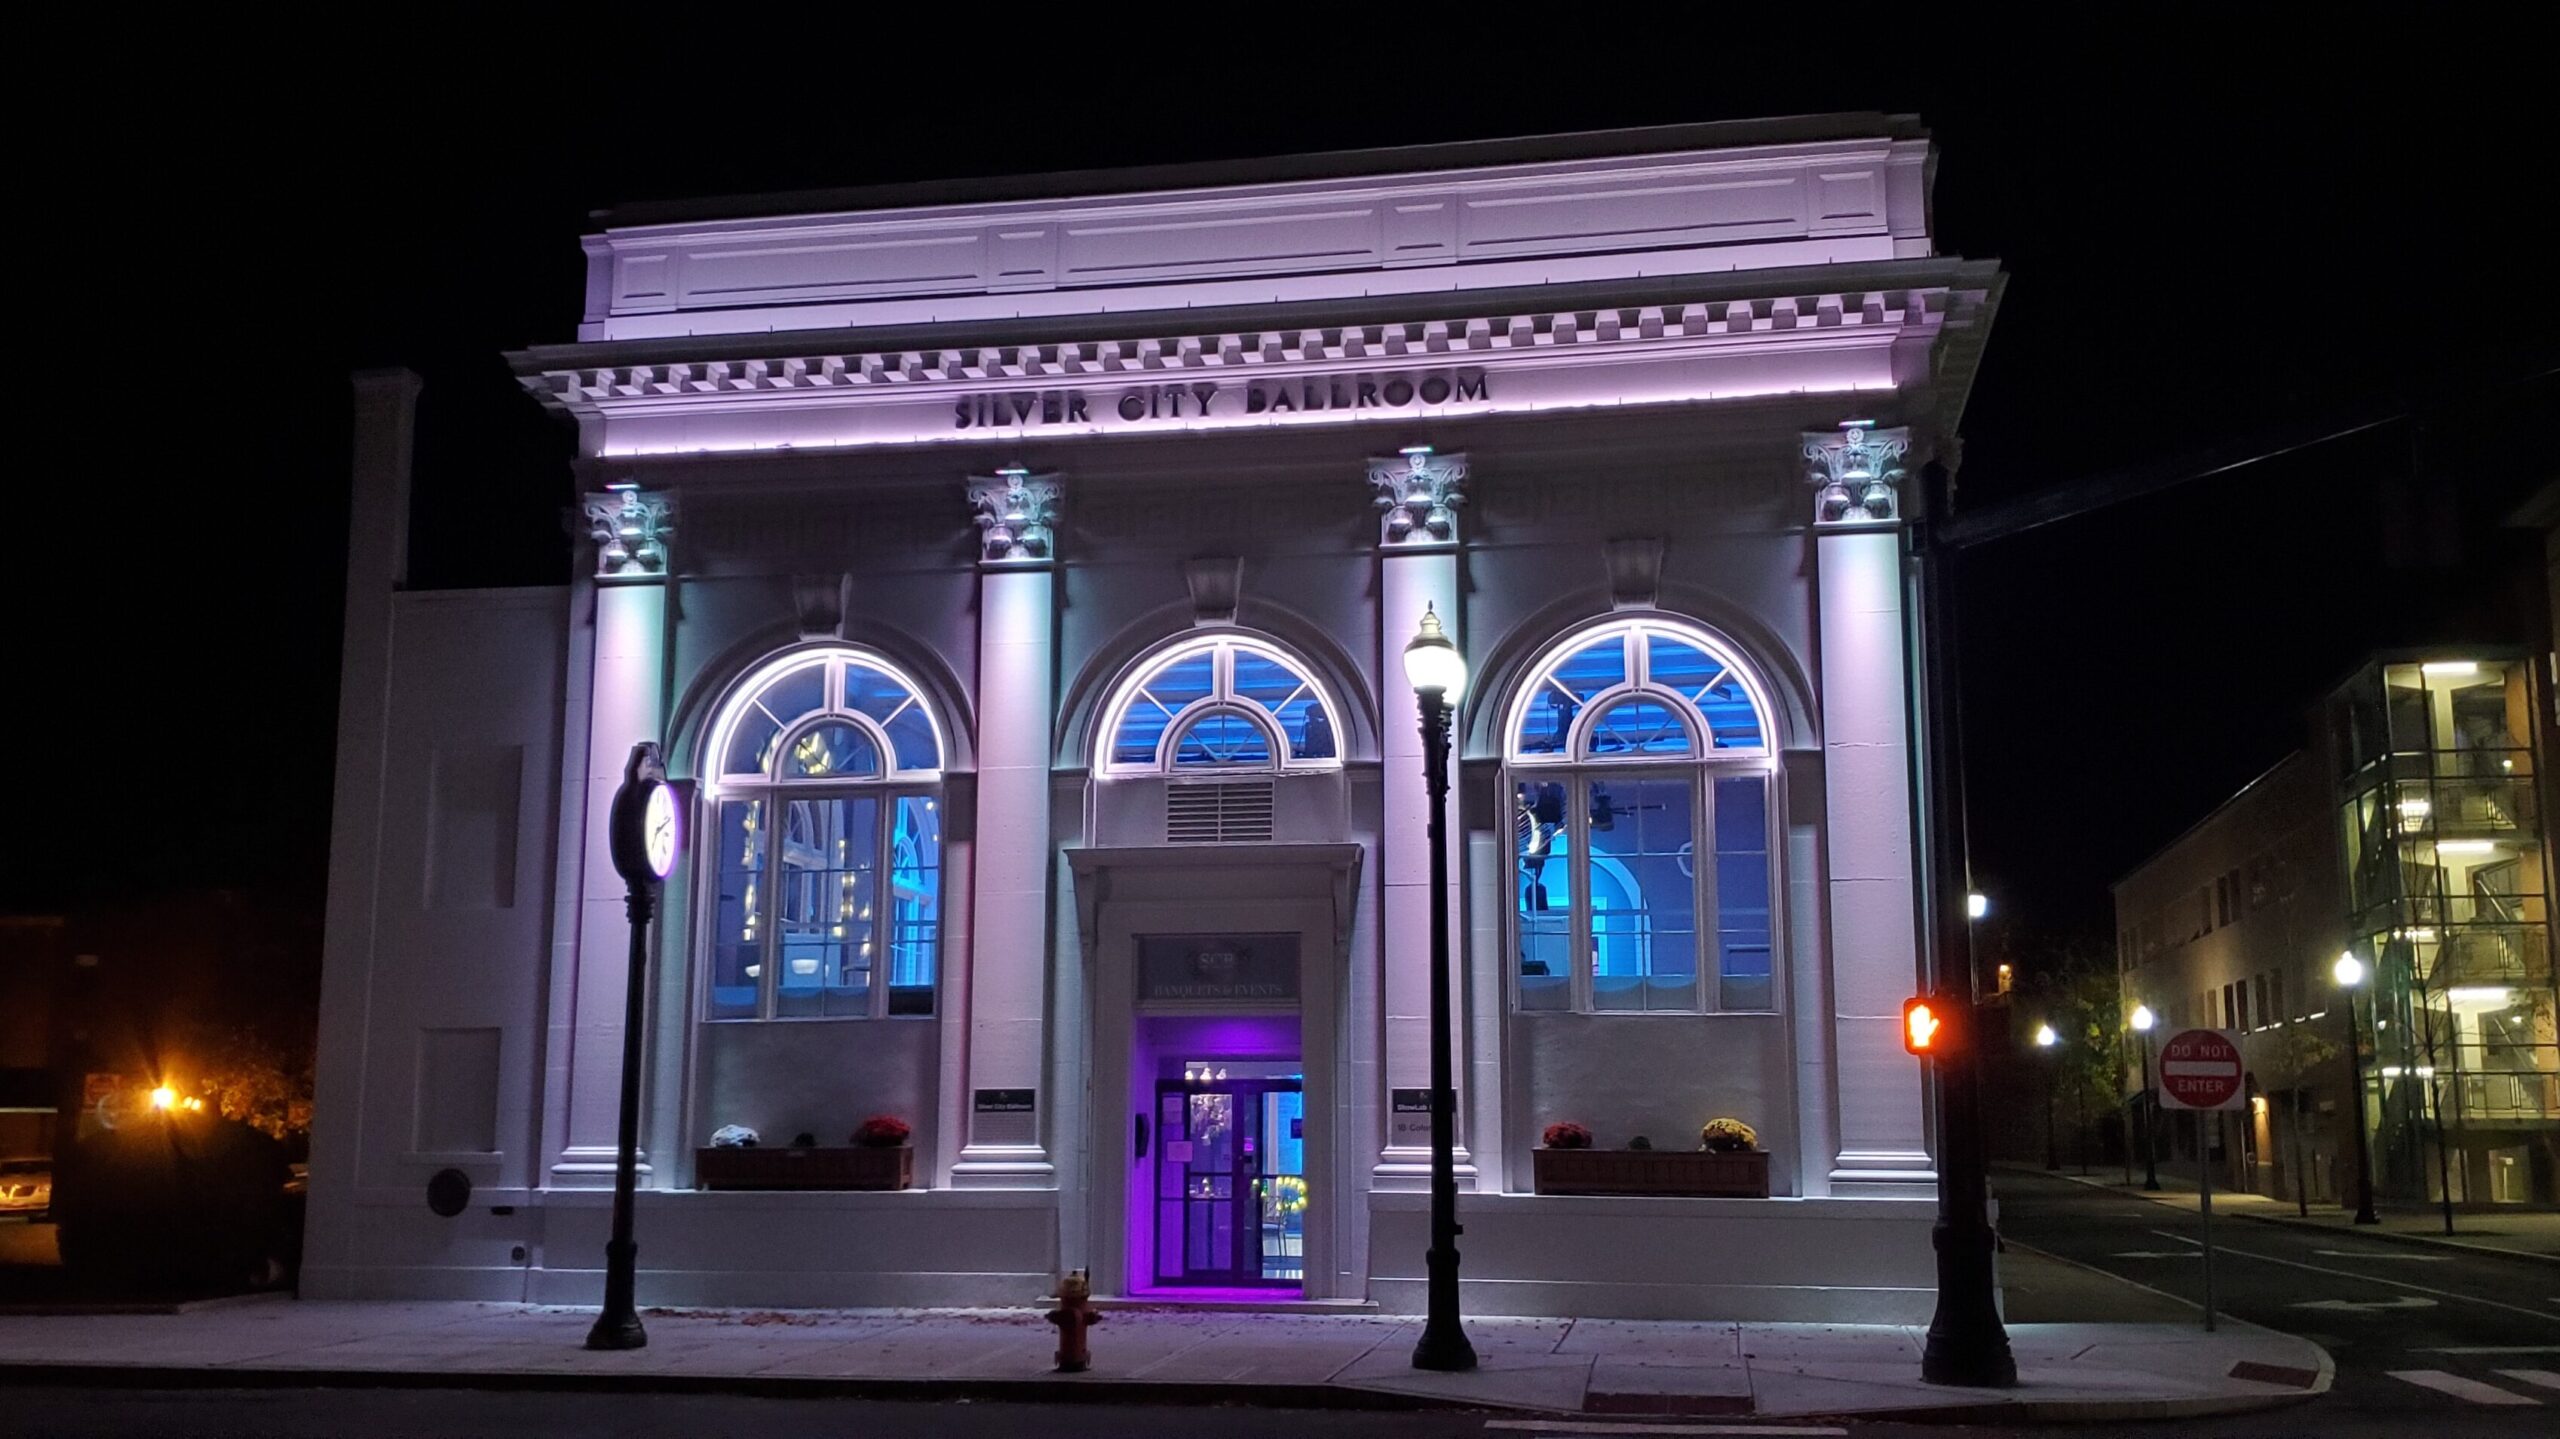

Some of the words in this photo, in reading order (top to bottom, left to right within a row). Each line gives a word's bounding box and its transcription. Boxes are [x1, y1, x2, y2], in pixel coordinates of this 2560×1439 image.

[955, 390, 1092, 430] SILVER
[1117, 382, 1219, 422] CITY
[1245, 374, 1490, 415] BALLROOM
[1235, 983, 1284, 996] EVENTS
[2171, 1044, 2191, 1057] DO
[2200, 1044, 2229, 1057] NOT
[2178, 1080, 2225, 1093] ENTER
